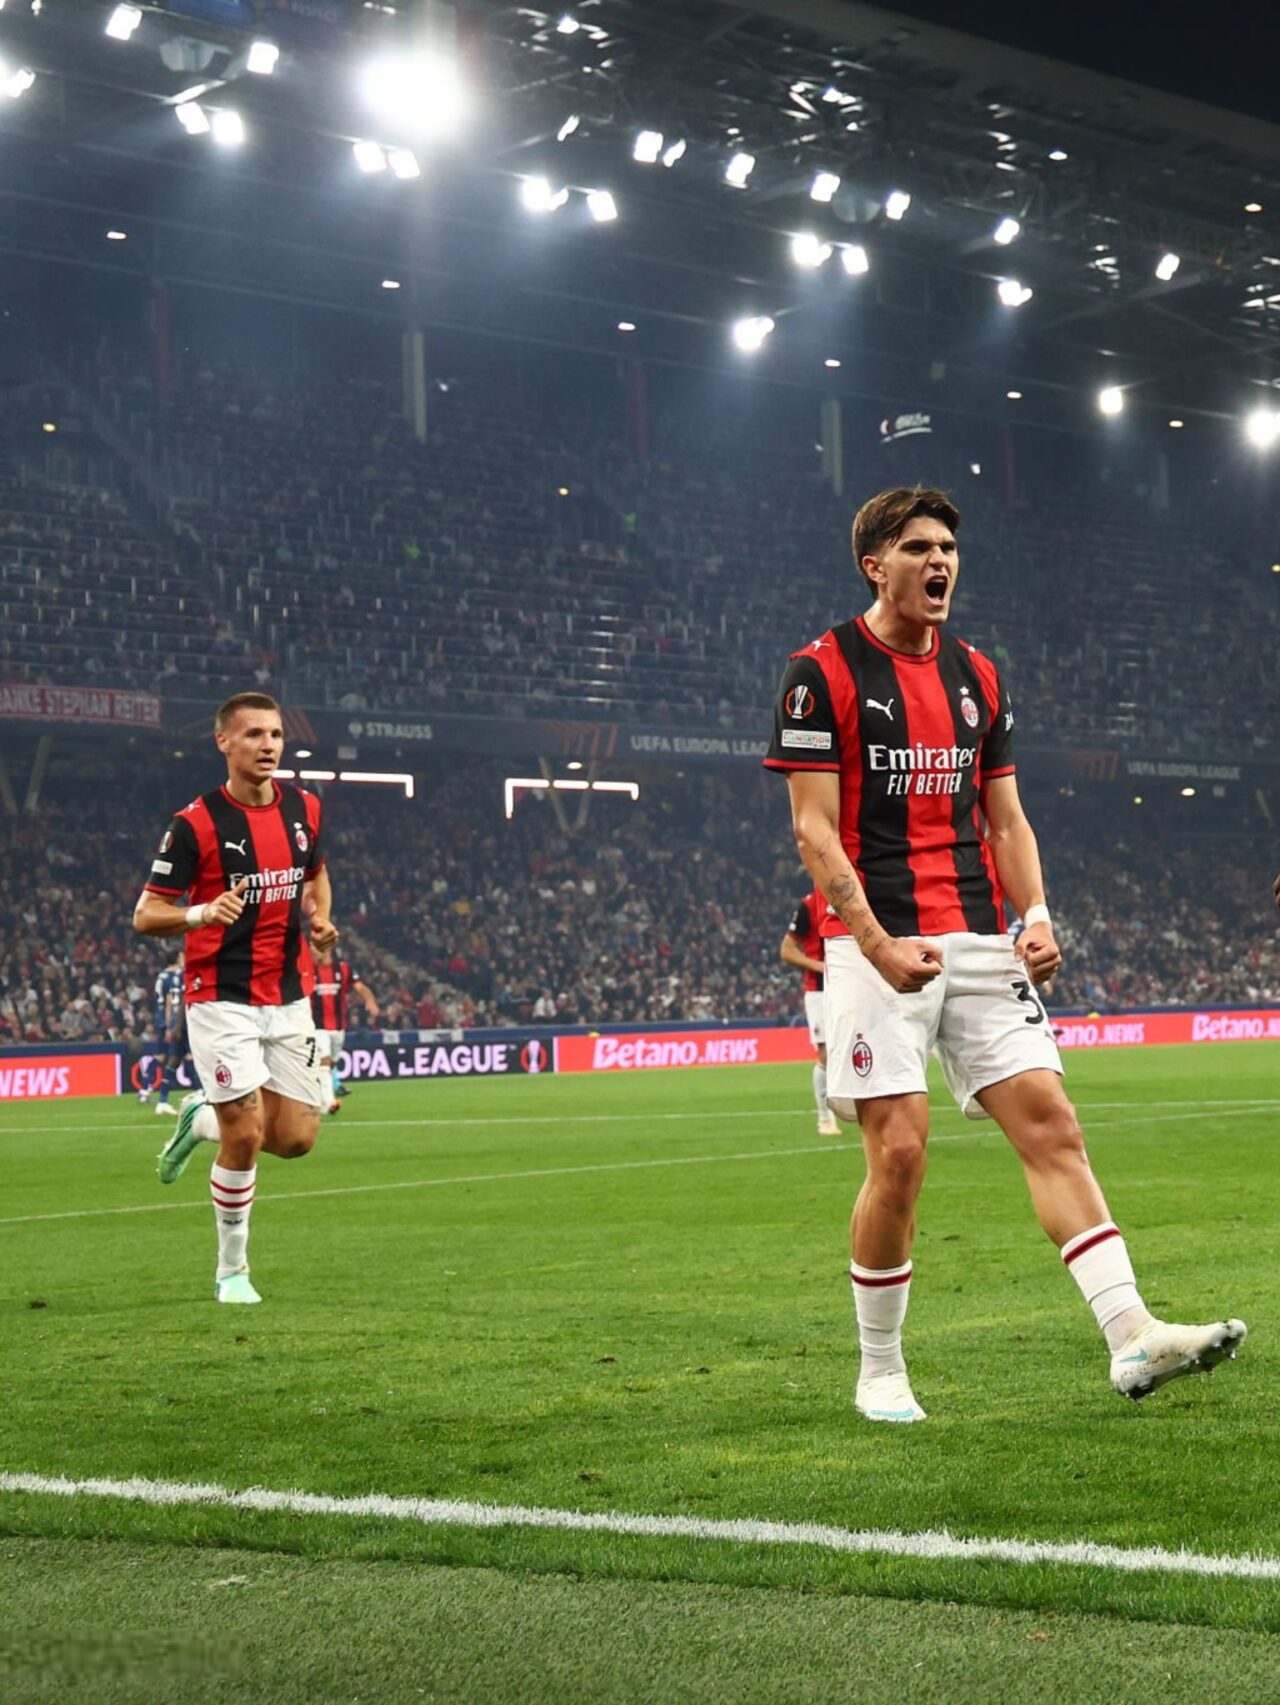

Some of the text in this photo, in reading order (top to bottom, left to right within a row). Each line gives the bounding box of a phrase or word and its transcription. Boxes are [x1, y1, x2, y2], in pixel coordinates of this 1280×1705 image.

[0, 687, 41, 712] ANKE
[365, 722, 432, 740] STRAUSS
[630, 736, 671, 750] UEFA
[673, 737, 731, 754] EUROPA
[868, 742, 976, 770] Emirates
[887, 772, 962, 795] FLY BETTER
[230, 866, 306, 890] Emirate
[265, 884, 298, 904] BETTER
[1011, 981, 1044, 1024] 3
[397, 1044, 508, 1077] LEAGUE
